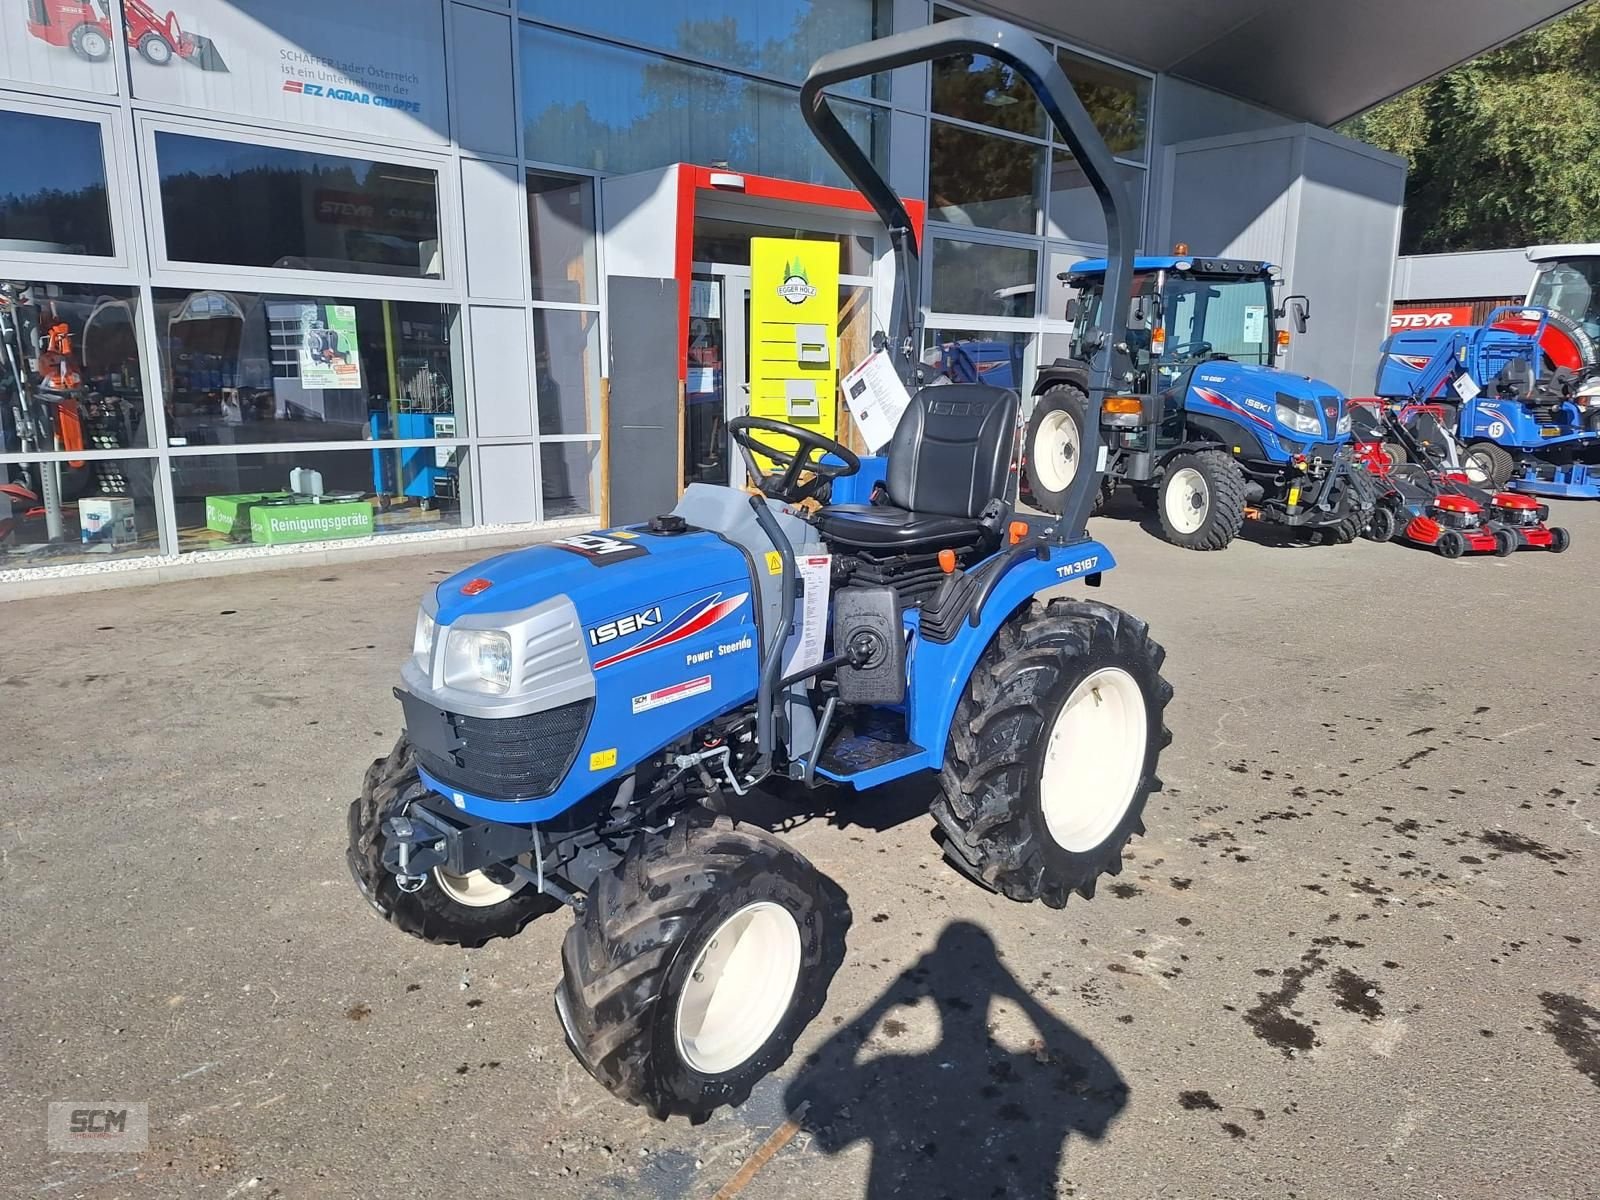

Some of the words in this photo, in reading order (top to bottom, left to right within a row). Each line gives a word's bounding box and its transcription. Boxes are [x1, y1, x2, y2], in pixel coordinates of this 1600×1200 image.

[280, 64, 295, 75] ist
[297, 68, 315, 78] ein
[317, 71, 391, 92] Unternehmen
[393, 84, 409, 95] der
[336, 61, 364, 73] Lader
[367, 64, 419, 83] Österreich
[303, 83, 323, 96] EZ
[326, 88, 370, 104] AGRAR
[372, 96, 421, 113] GRUPPE
[1390, 313, 1453, 327] STEYR
[1245, 398, 1271, 413] ISEKI
[1491, 425, 1501, 436] 15
[270, 511, 369, 534] Reinigungsgeräte
[1056, 564, 1074, 578] TM
[1073, 556, 1099, 573] 3187
[588, 606, 663, 647] ISEKI
[686, 650, 714, 666] Power
[718, 637, 752, 656] Steering
[634, 695, 648, 705] SCM
